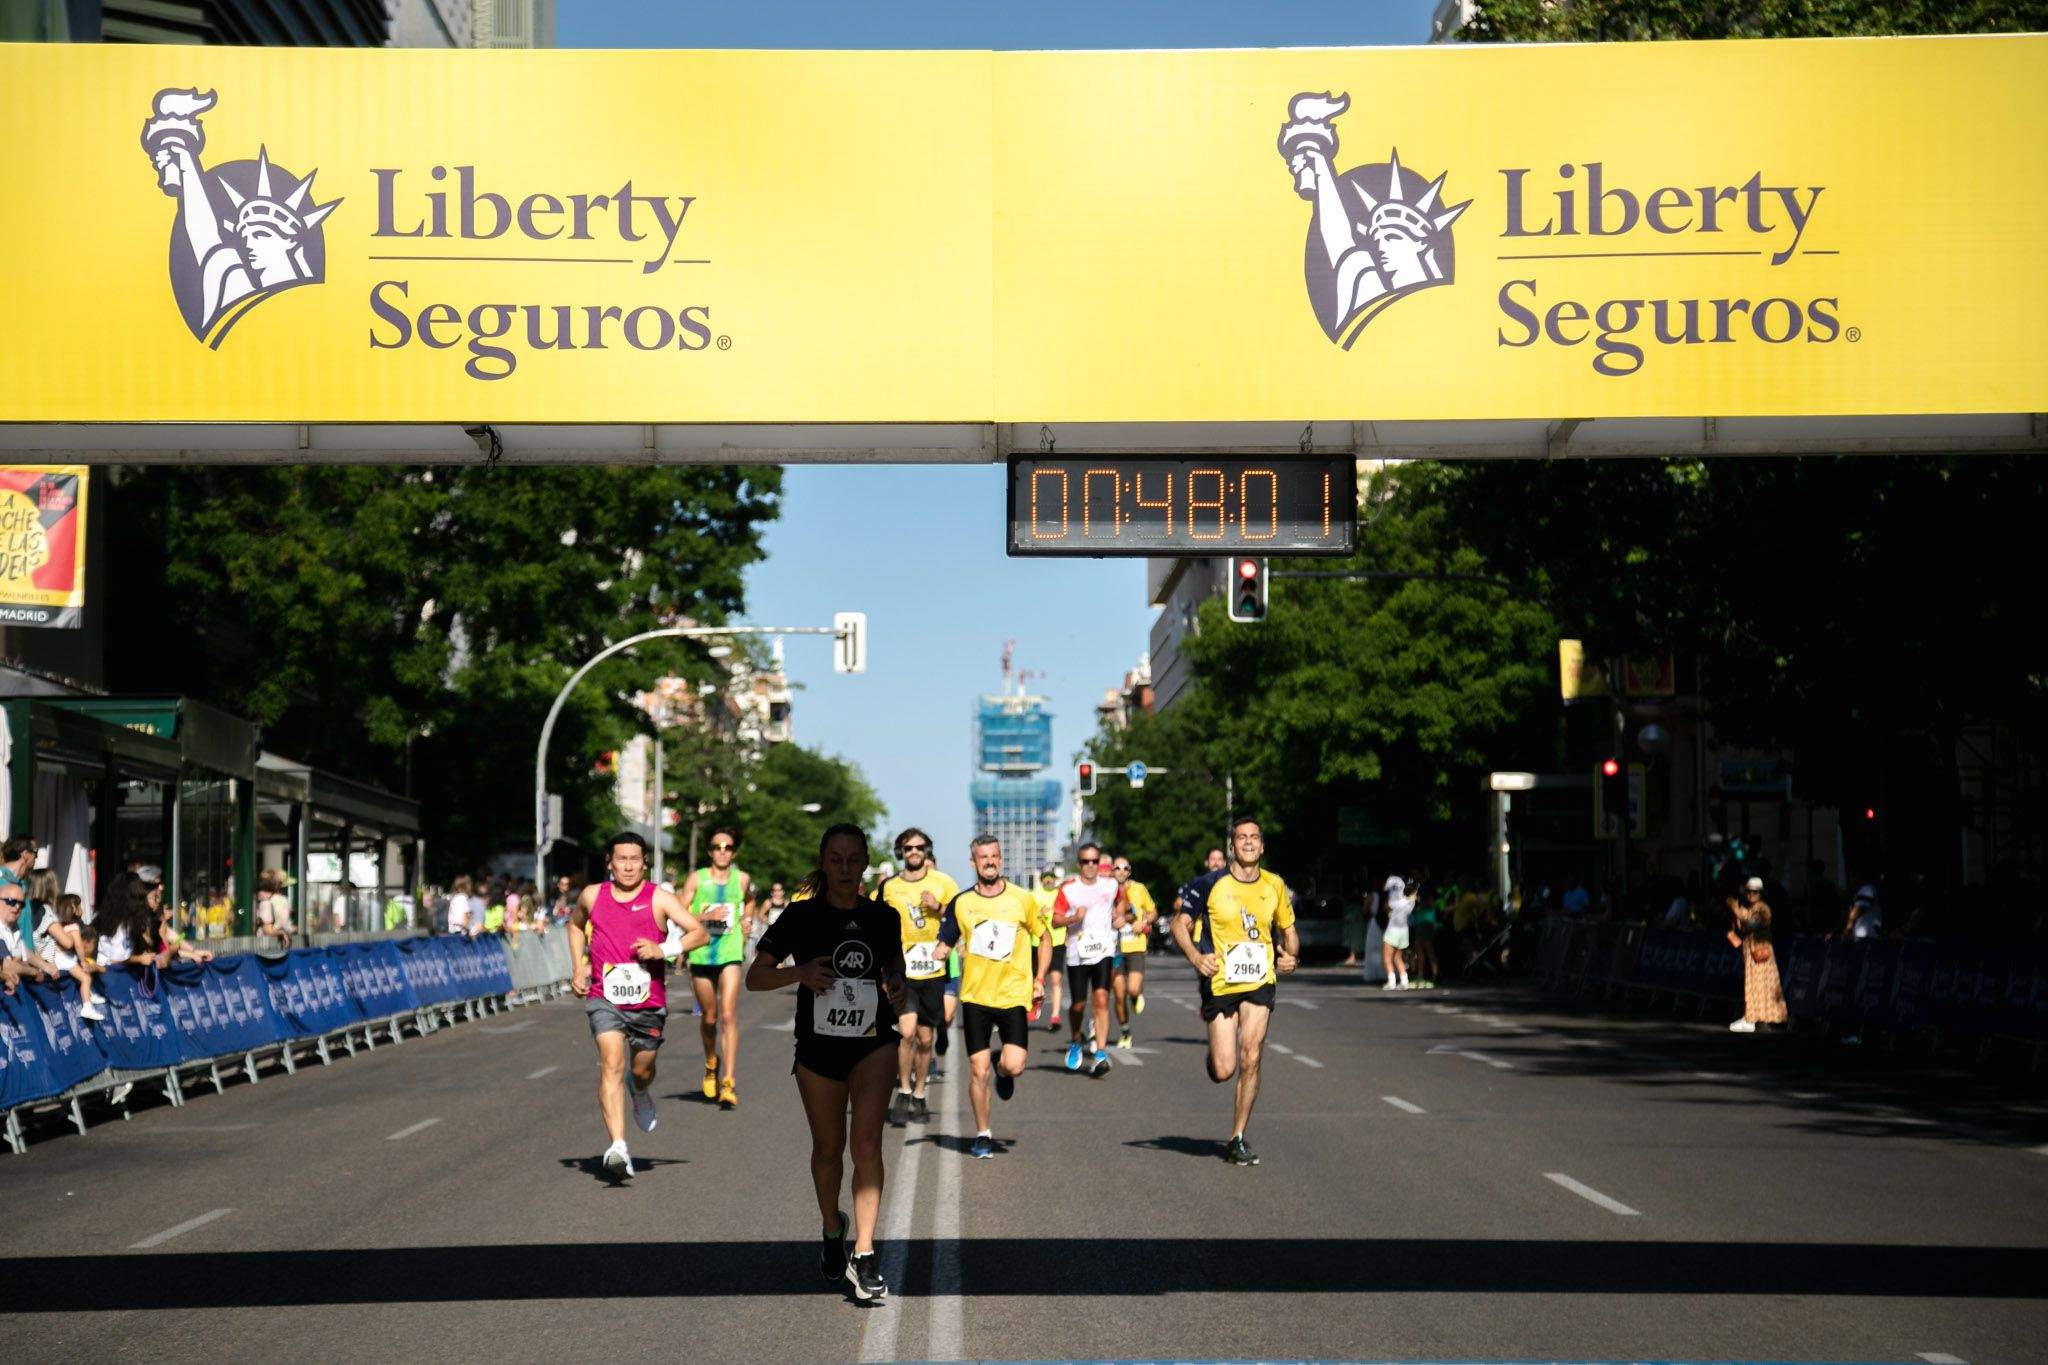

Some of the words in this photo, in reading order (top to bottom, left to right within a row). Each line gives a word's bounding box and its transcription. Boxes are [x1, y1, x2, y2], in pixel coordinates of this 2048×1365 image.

[369, 165, 697, 275] Liberty
[1498, 162, 1826, 266] Liberty
[0, 509, 34, 532] CHE
[0, 607, 49, 622] MADRID
[1233, 963, 1261, 975] 2964
[612, 985, 641, 997] 3004
[827, 1008, 865, 1026] 4247
